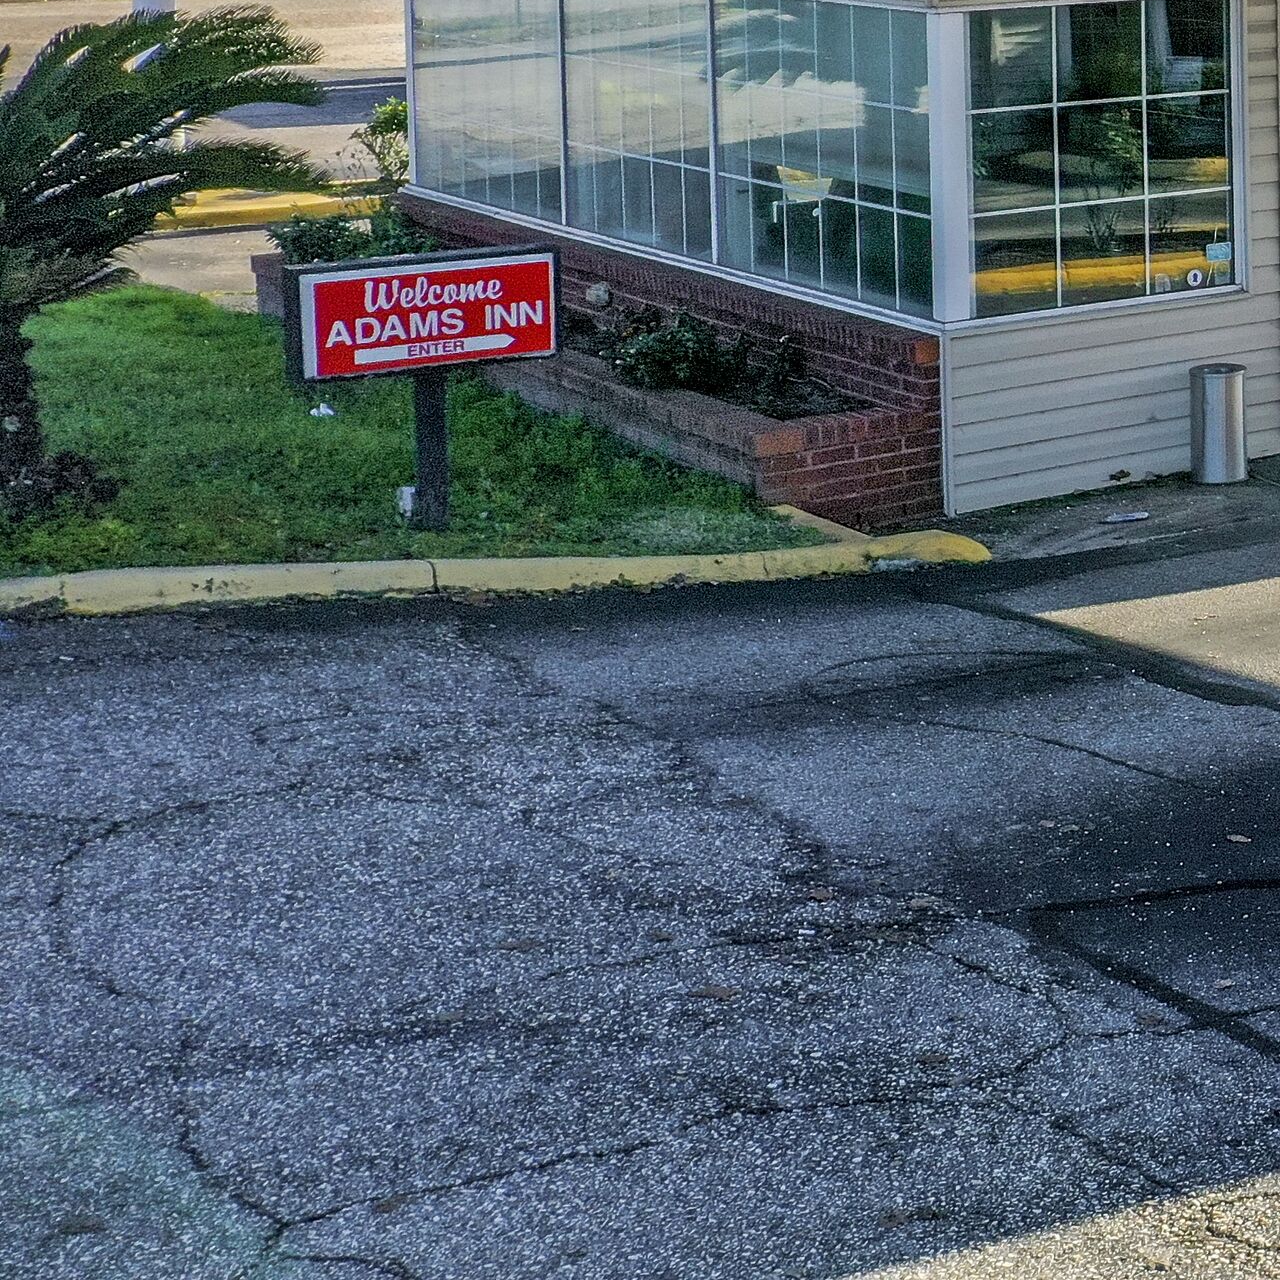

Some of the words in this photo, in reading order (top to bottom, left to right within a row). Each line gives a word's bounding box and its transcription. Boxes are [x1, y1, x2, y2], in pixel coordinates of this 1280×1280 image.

[364, 277, 503, 313] Welcome
[325, 309, 464, 348] ADAMS
[484, 300, 543, 330] INN
[407, 339, 465, 358] ENTER
